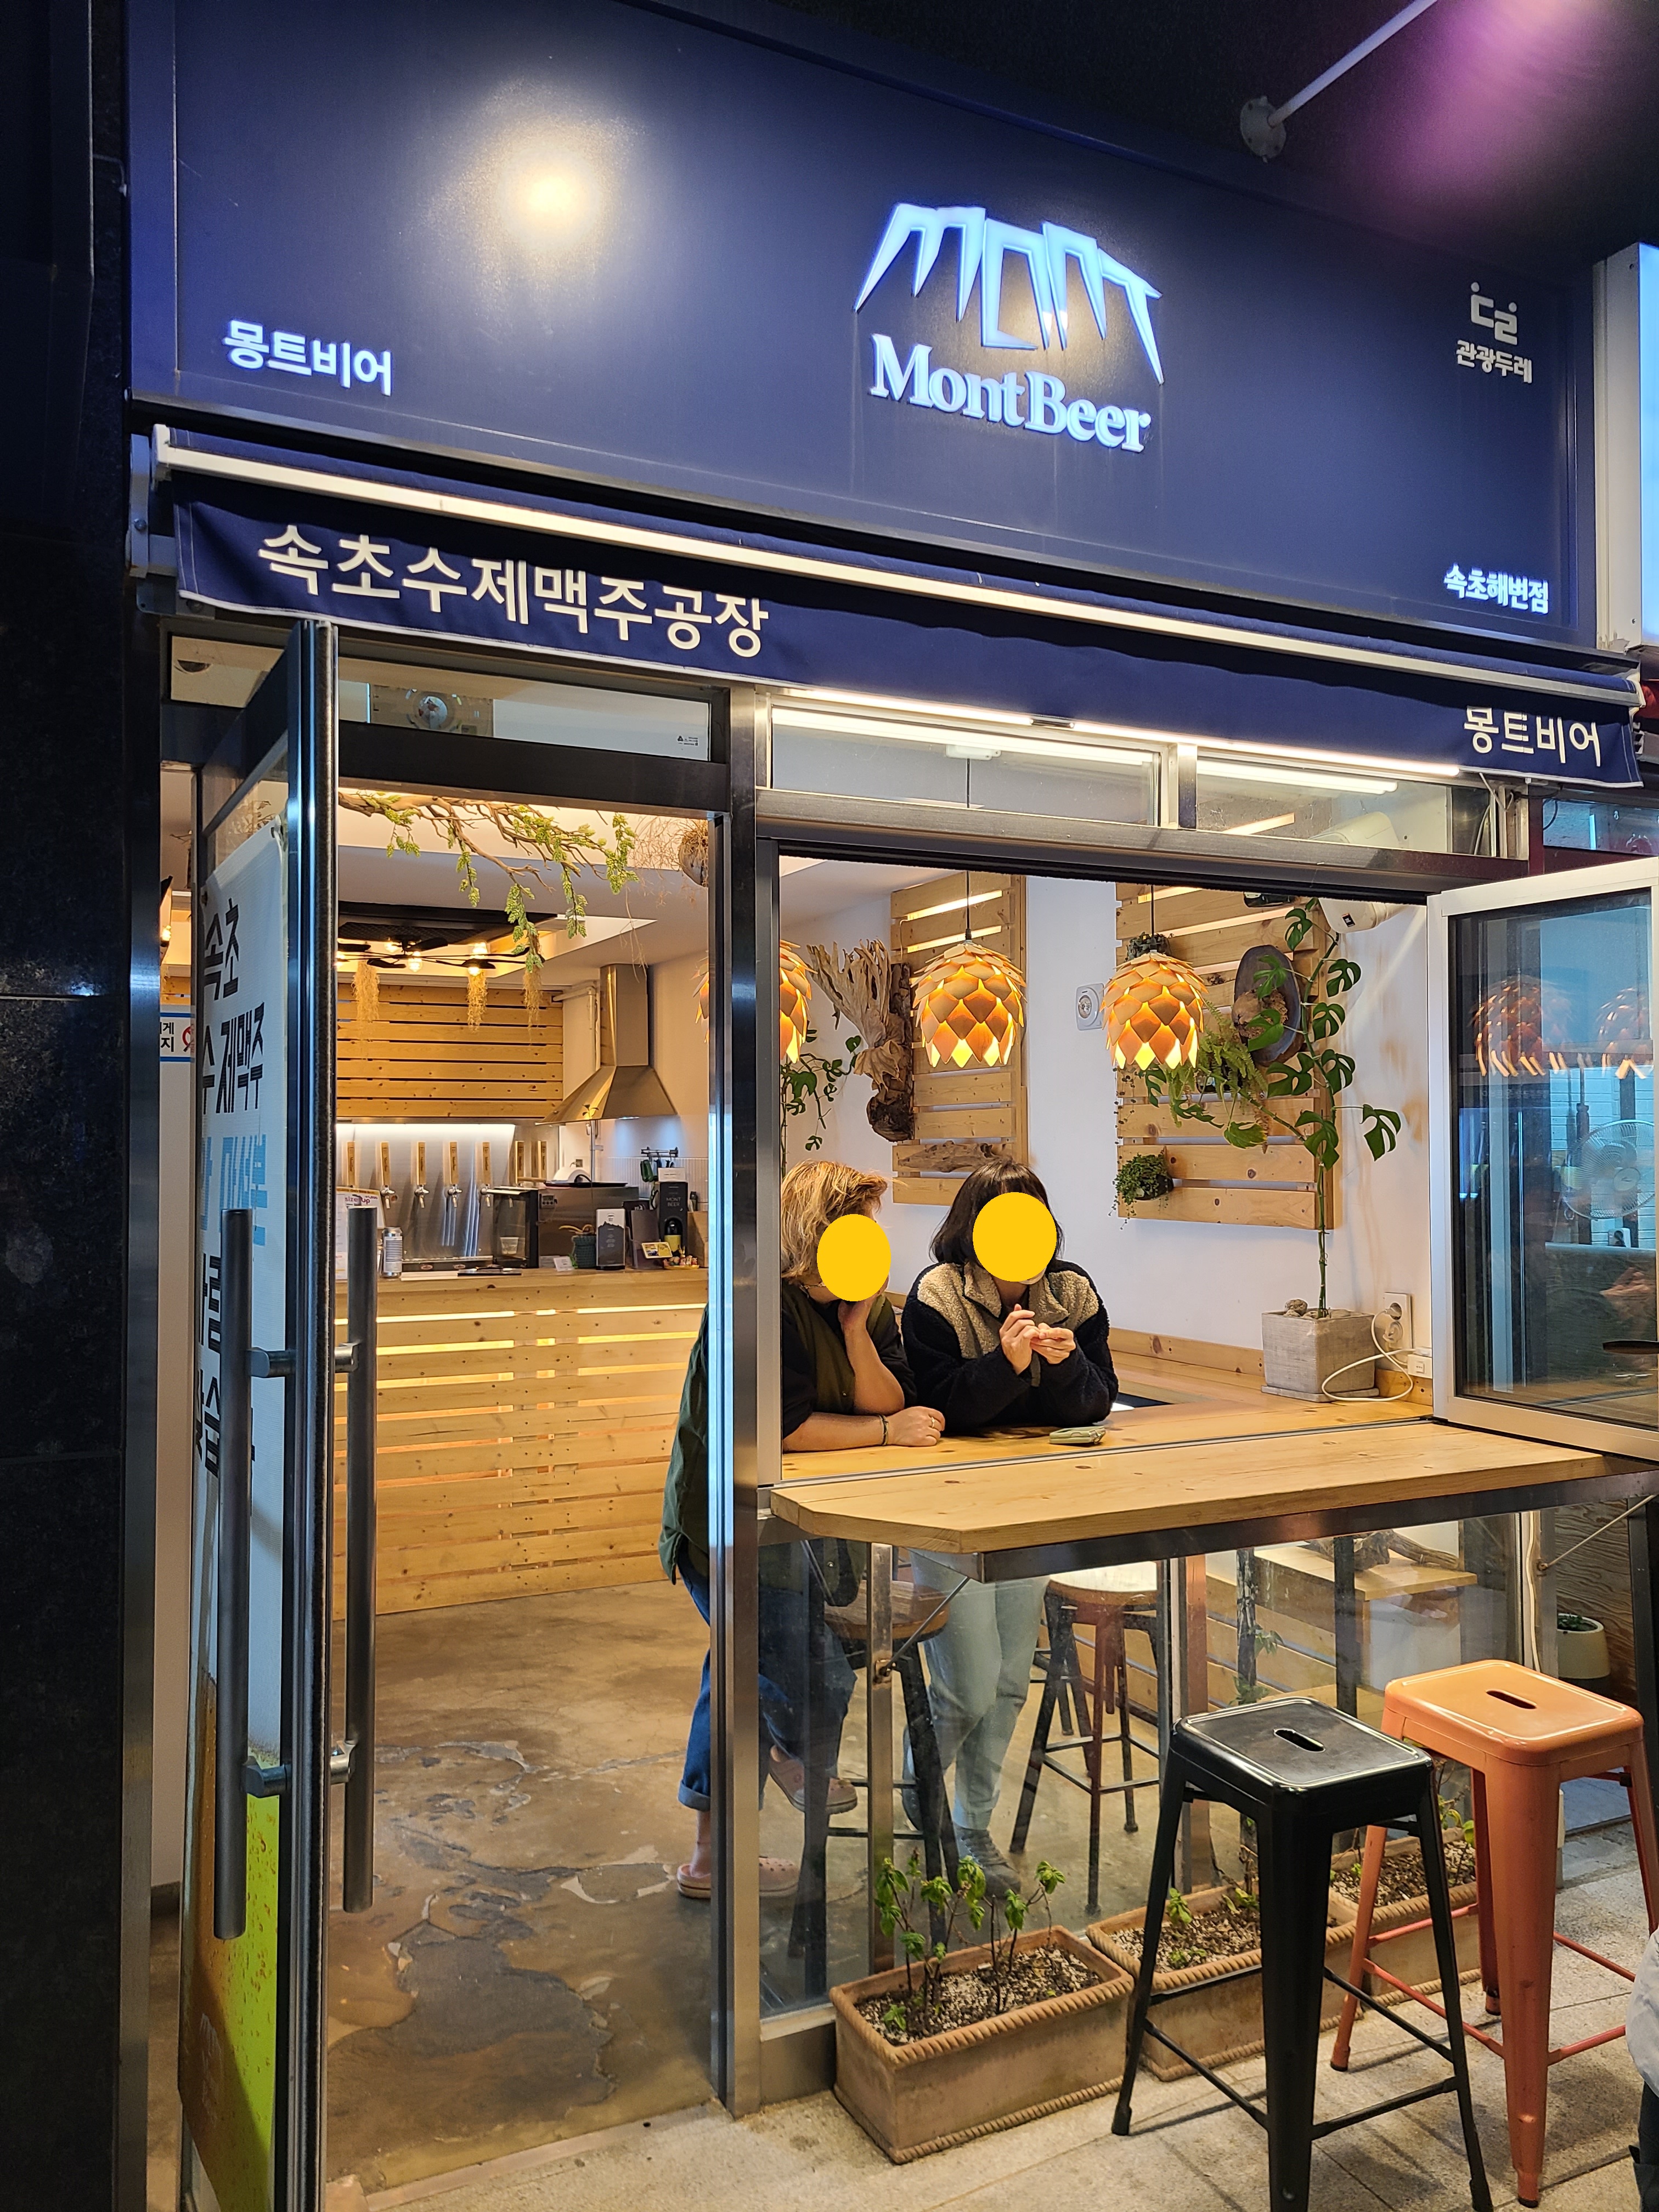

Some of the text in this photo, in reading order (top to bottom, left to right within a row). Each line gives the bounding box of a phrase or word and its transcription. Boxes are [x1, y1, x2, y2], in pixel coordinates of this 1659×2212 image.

[222, 319, 393, 396] 몽트비어
[1456, 340, 1532, 384] 관광두레
[1443, 562, 1549, 614] 속초해변점
[1464, 706, 1601, 767] 몽트비어
[202, 898, 240, 1001] 속초
